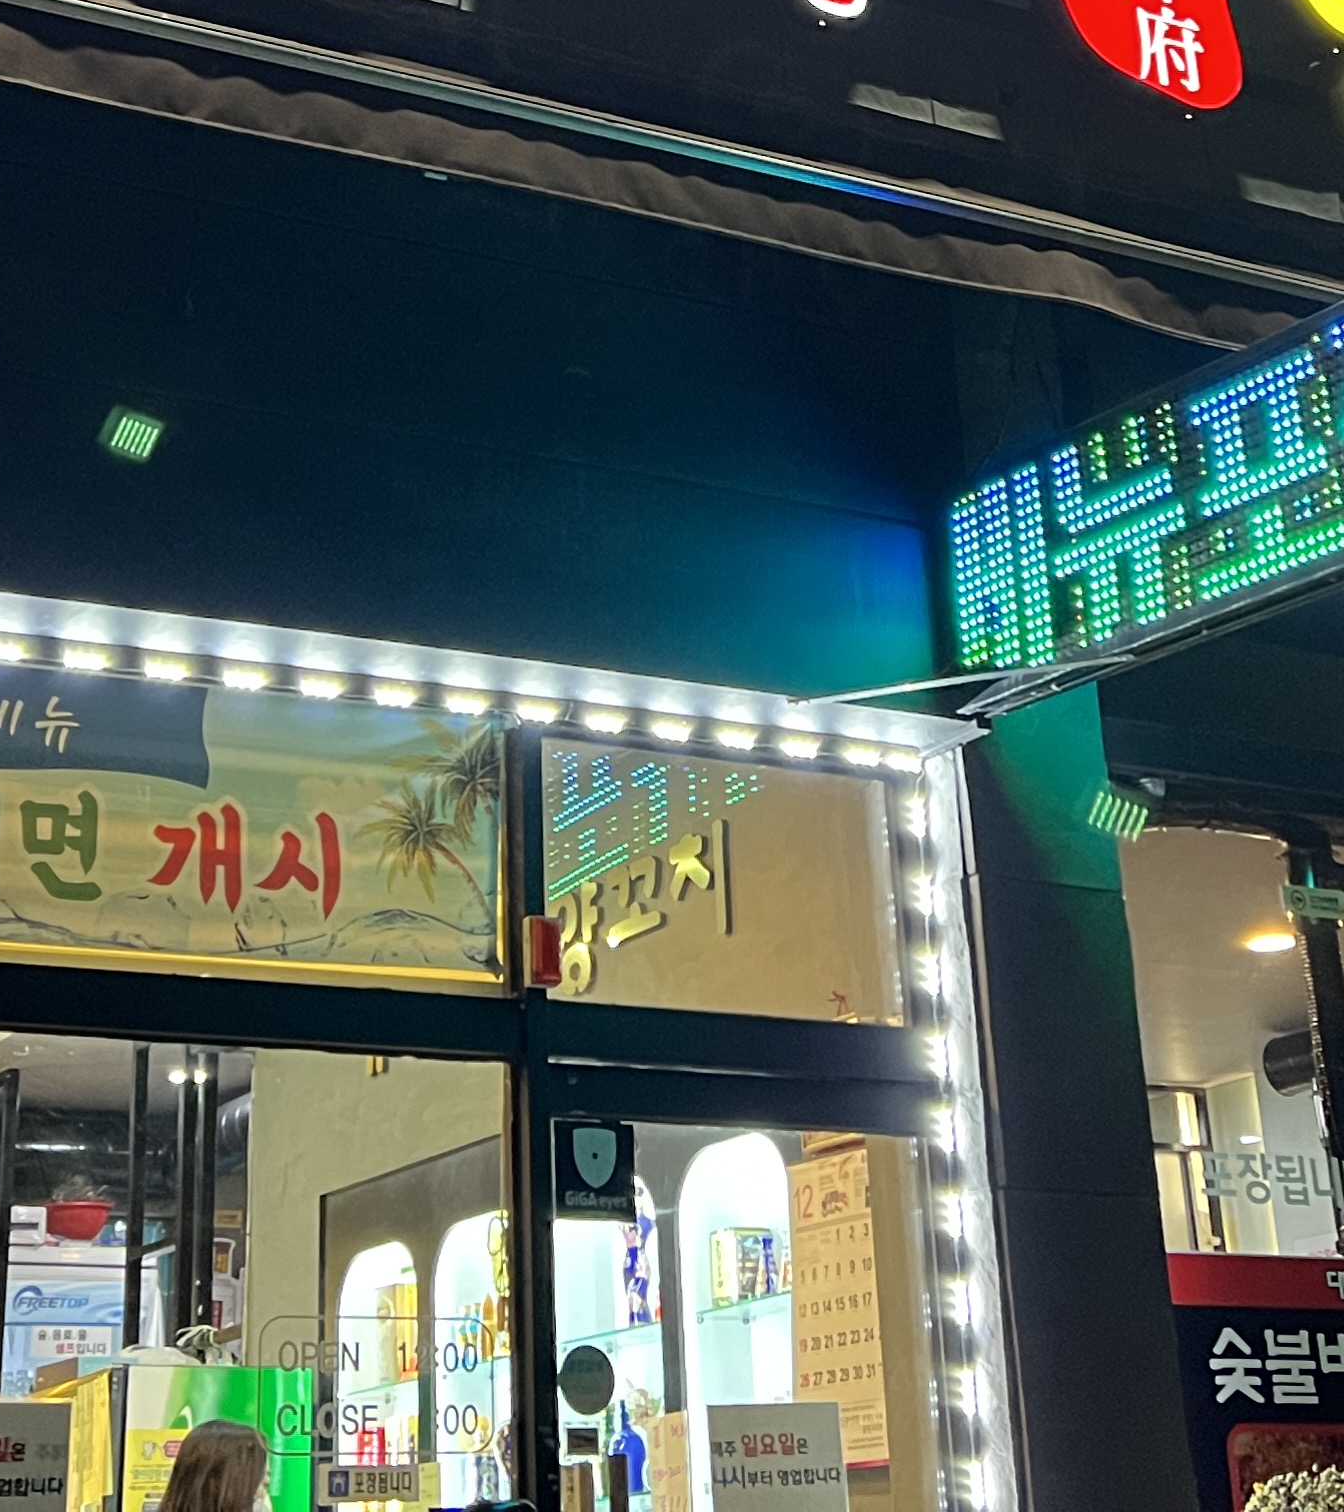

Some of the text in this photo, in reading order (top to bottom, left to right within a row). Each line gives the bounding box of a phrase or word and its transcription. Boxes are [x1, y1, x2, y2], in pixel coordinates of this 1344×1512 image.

[148, 803, 341, 919] 개시
[794, 1184, 813, 1220] 12
[17, 1295, 89, 1311] FREETOP
[278, 1340, 360, 1372] OPEN
[277, 1402, 378, 1438] CLOSE
[710, 1433, 808, 1457] 매주 일요일은
[777, 1467, 841, 1486] 영업합니다
